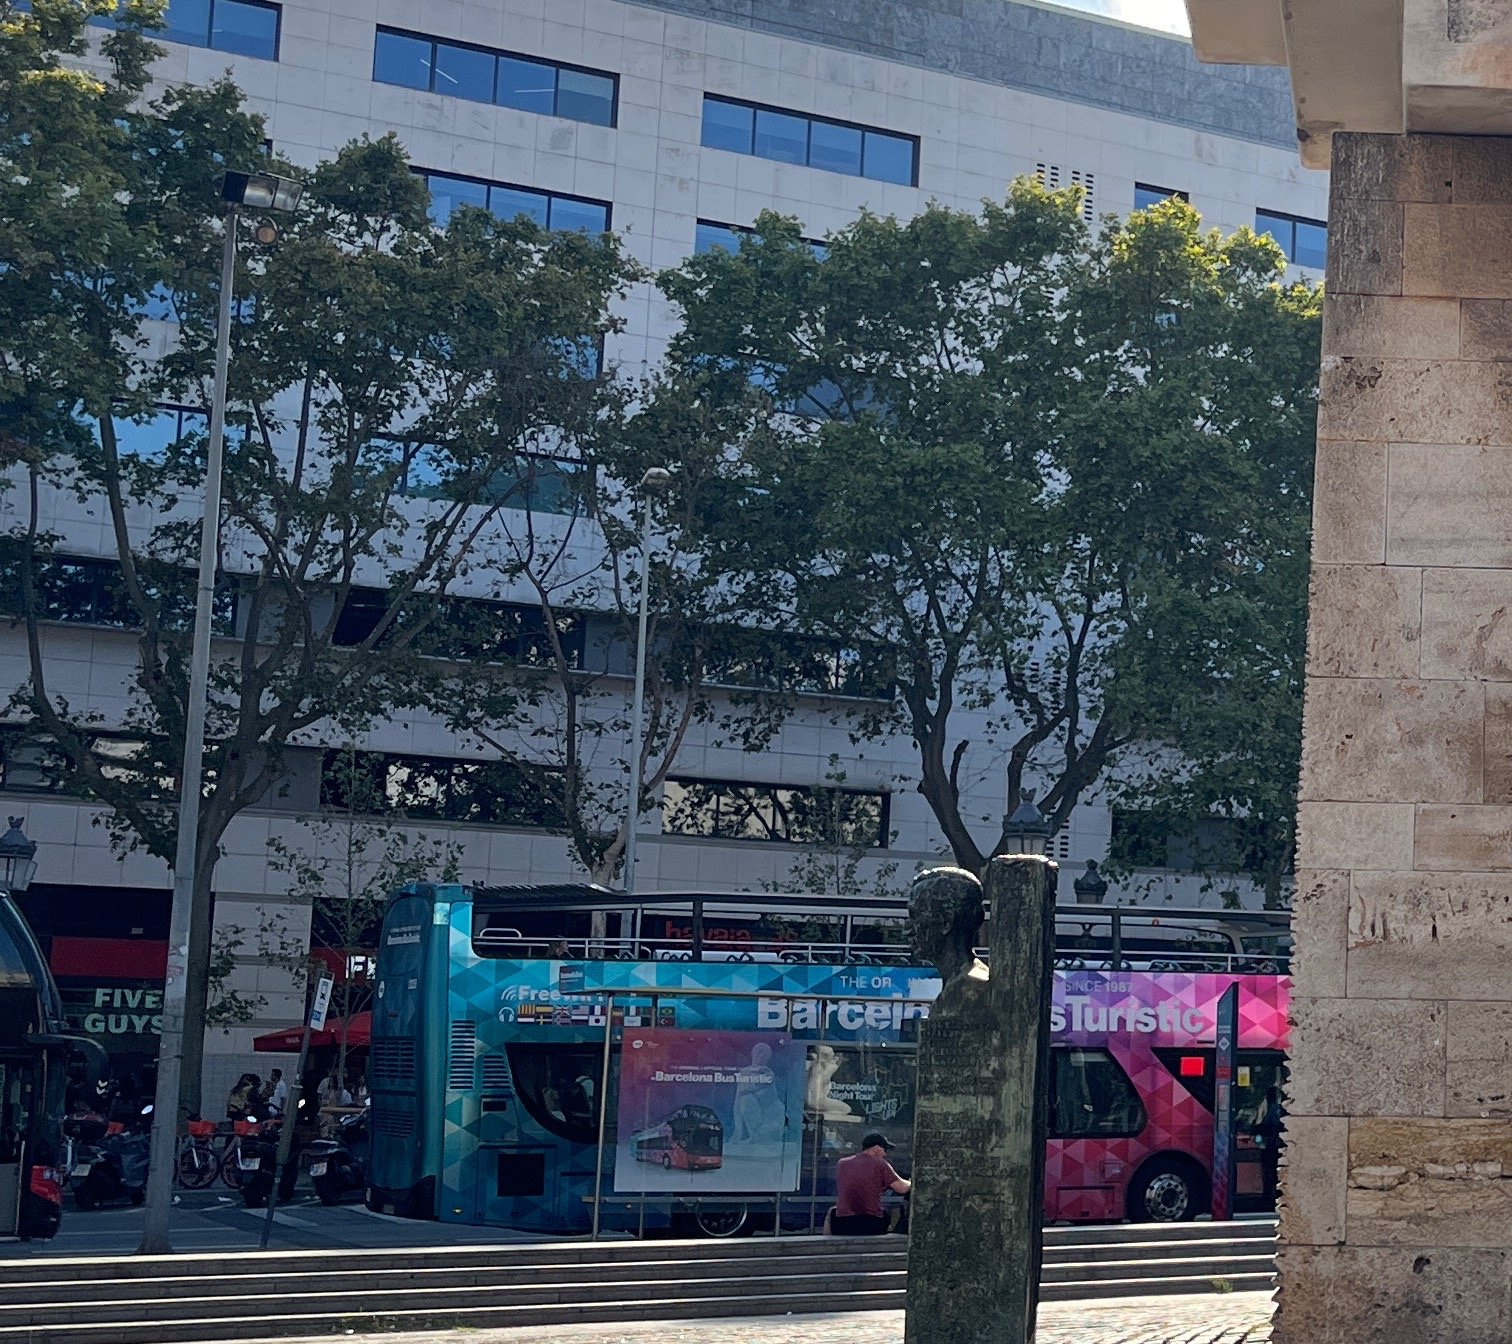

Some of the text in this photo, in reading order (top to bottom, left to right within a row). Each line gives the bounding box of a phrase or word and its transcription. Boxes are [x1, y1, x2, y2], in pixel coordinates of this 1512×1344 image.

[839, 975, 868, 989] THE
[1065, 980, 1101, 992] SINCE
[94, 988, 163, 1009] FIVE
[84, 1013, 163, 1035] GUYS
